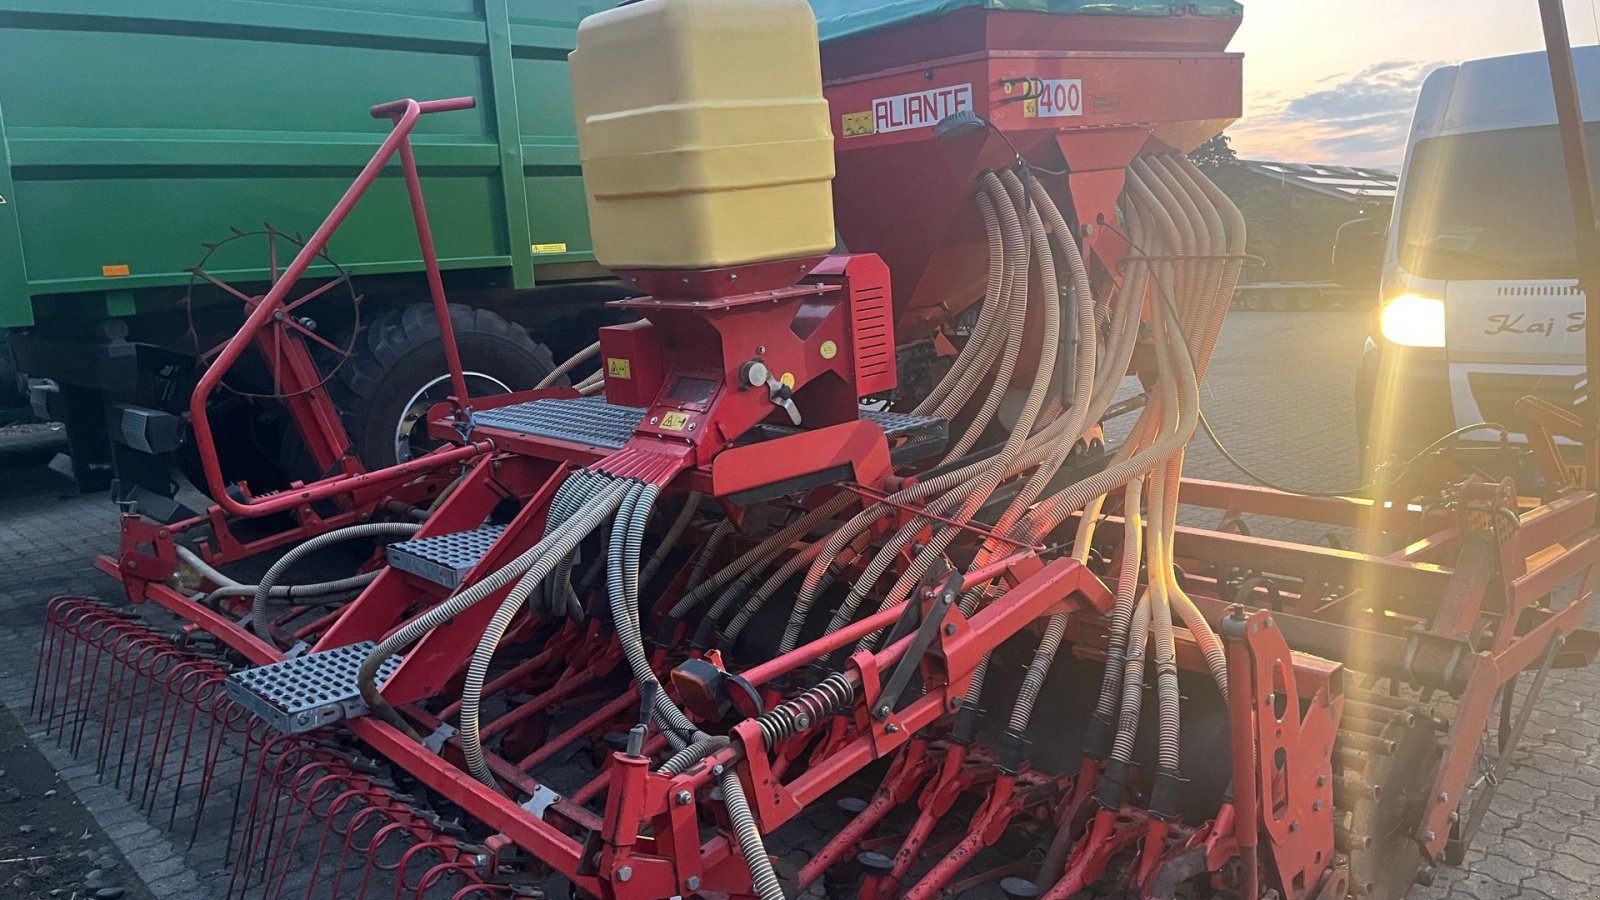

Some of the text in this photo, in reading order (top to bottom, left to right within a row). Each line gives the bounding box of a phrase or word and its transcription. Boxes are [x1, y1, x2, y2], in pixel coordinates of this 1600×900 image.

[875, 87, 968, 129] ALIANTE
[1039, 83, 1080, 113] 400
[1484, 313, 1556, 338] Kaj
